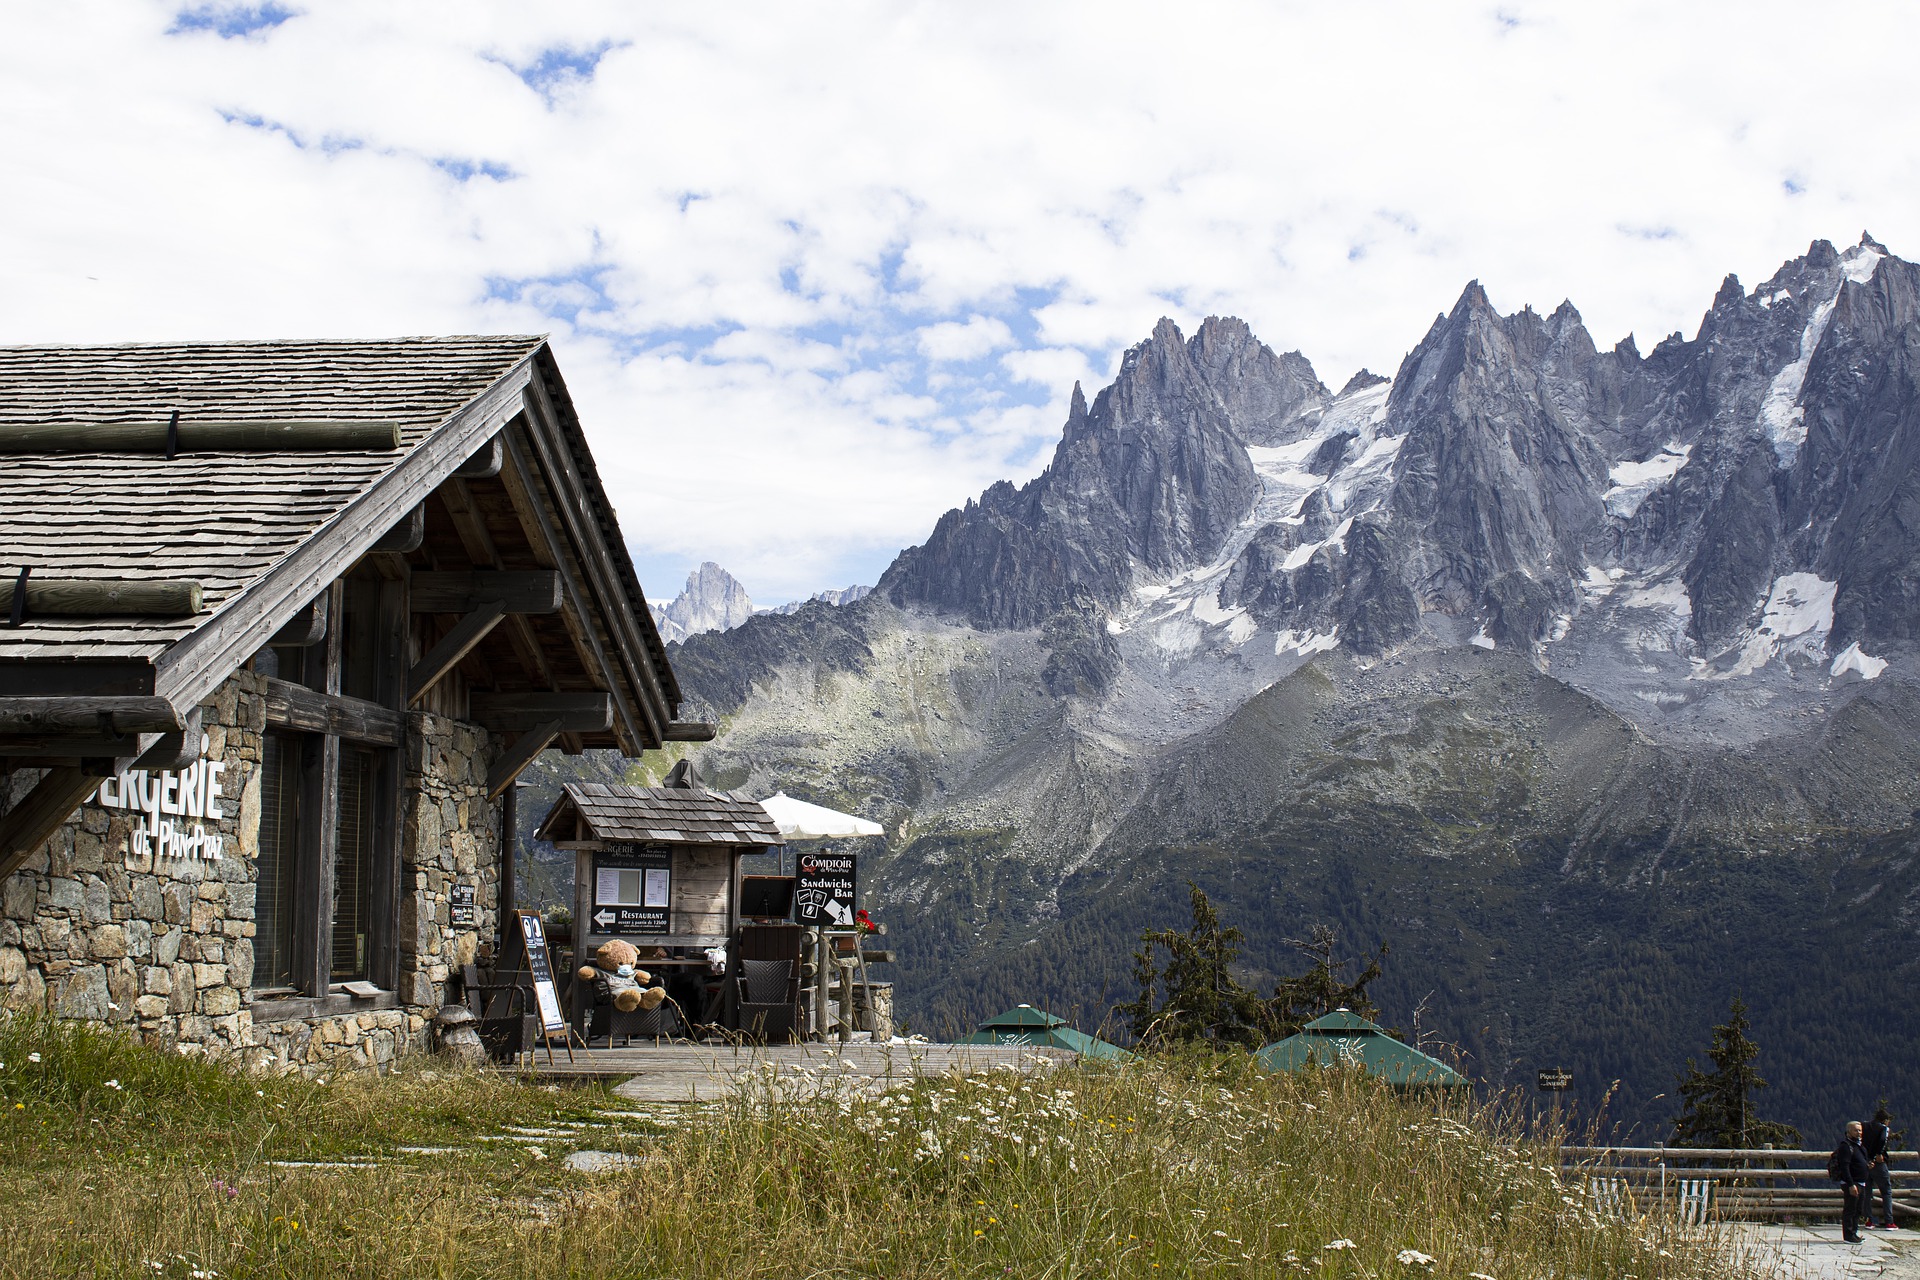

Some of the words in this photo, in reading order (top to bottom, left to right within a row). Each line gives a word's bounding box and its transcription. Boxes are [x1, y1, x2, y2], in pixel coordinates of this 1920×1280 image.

[83, 733, 225, 837] ERGERIE
[834, 888, 853, 898] BAR
[621, 910, 664, 920] RESTAURANT
